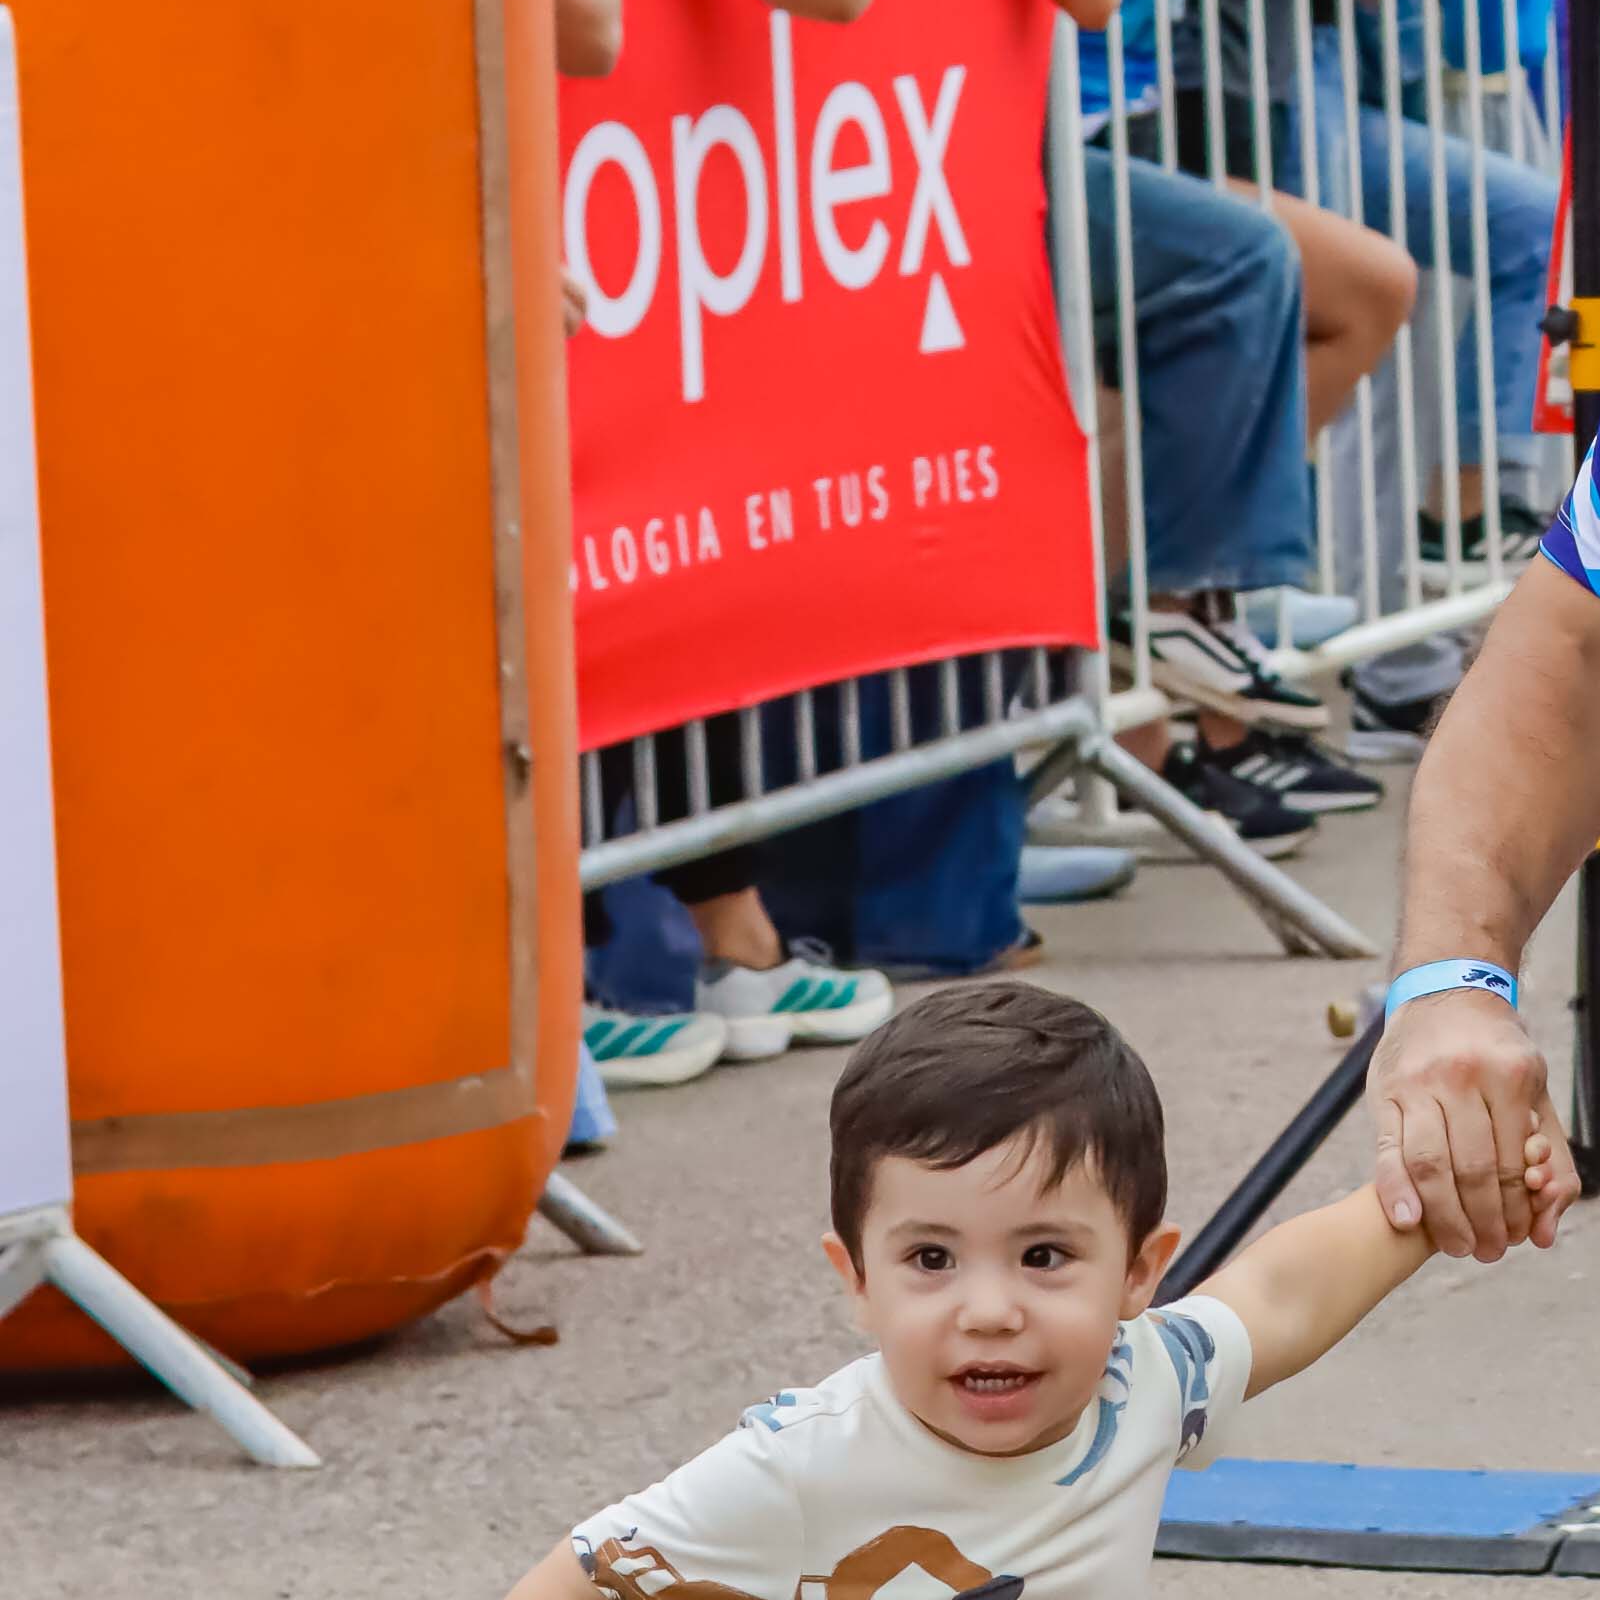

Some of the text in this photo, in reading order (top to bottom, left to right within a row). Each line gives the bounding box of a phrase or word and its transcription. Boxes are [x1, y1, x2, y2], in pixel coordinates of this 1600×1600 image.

[568, 444, 1001, 592] LOGIA EN TUS PIES
